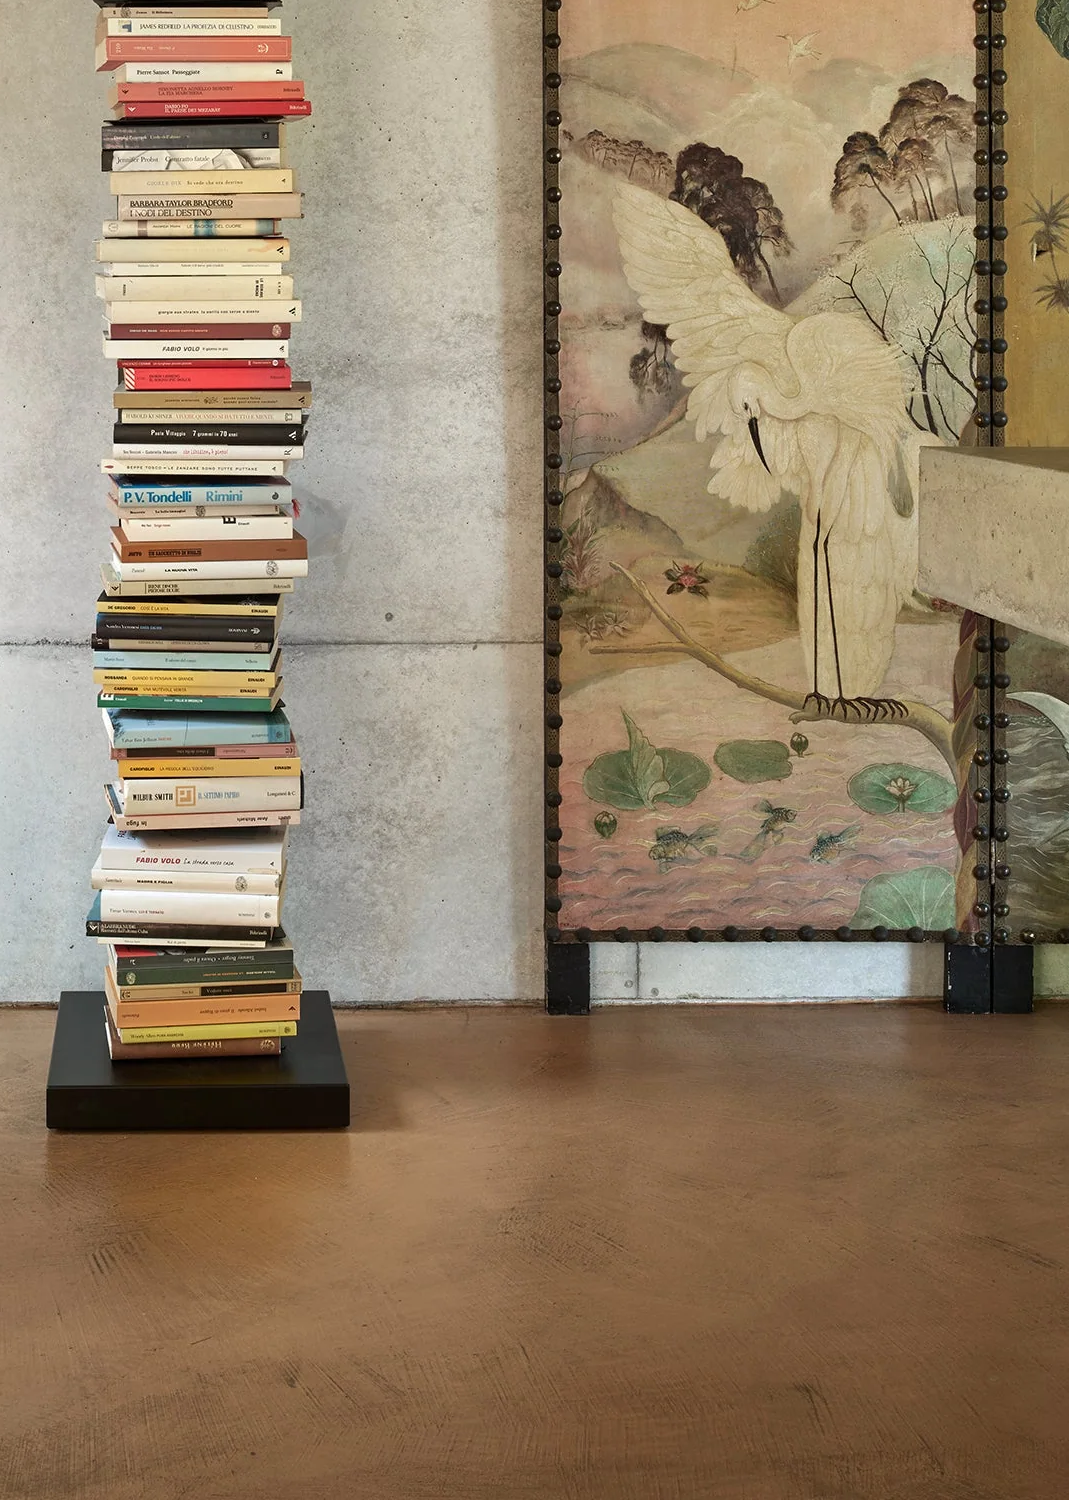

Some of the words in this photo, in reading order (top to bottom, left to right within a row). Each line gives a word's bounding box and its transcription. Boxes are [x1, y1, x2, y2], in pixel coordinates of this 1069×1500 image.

[172, 69, 200, 77] Passeggiate
[116, 156, 138, 164] Jennifer
[130, 200, 164, 208] BARBARA
[194, 199, 234, 208] BRADFORD
[133, 209, 156, 217] NODI
[157, 209, 174, 217] DEL
[175, 209, 213, 217] DESTINO
[124, 492, 133, 503] P.
[134, 492, 145, 503] V.
[146, 491, 192, 503] Tondelli
[206, 490, 243, 502] Rimini
[132, 793, 153, 801] WILBUR
